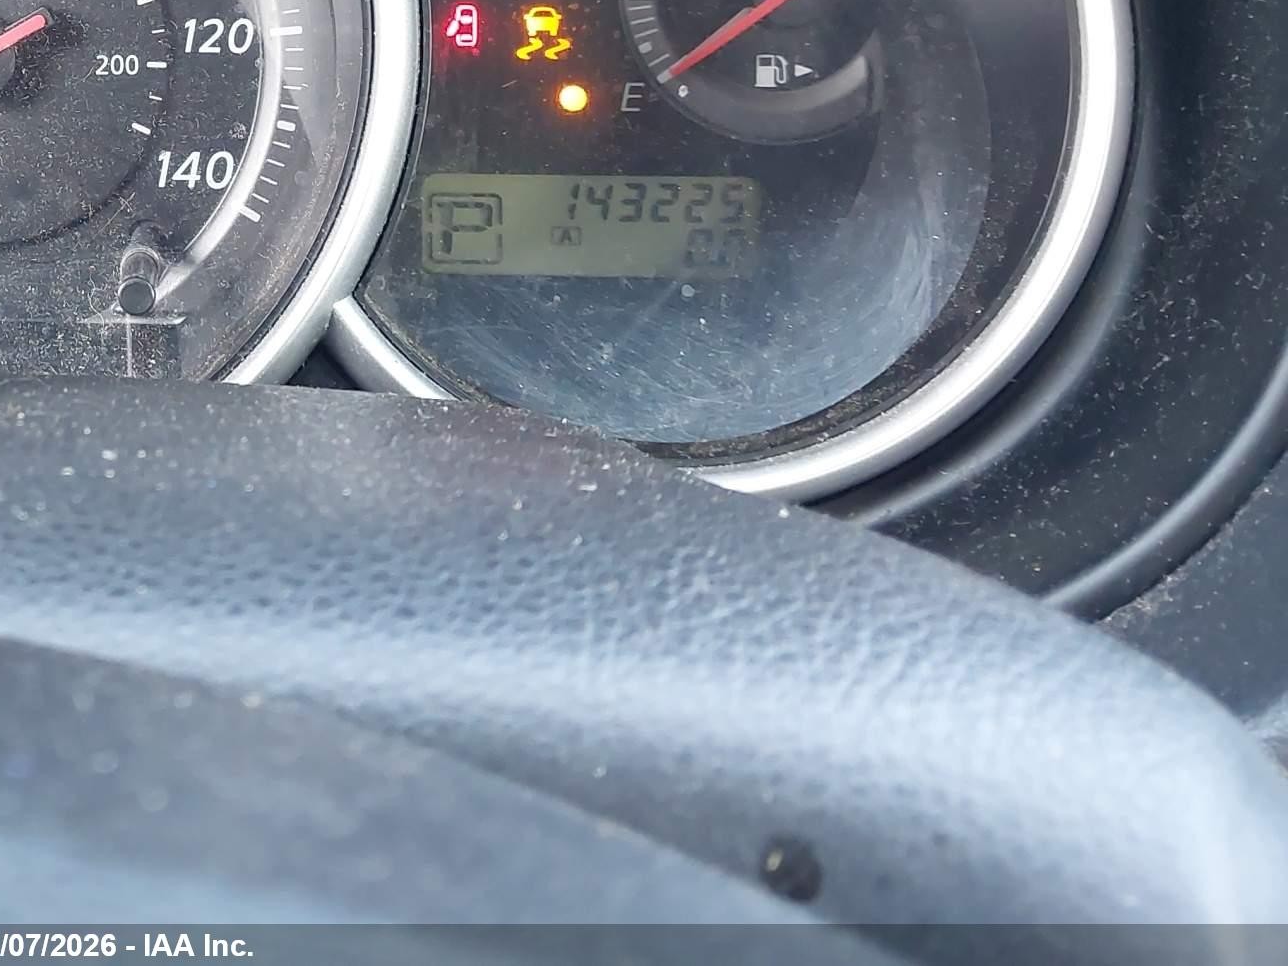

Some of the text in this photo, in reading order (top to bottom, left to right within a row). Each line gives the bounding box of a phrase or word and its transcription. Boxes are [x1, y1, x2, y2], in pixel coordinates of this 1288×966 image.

[184, 18, 254, 54] 120
[95, 55, 139, 75] 200
[620, 82, 645, 112] E
[157, 151, 234, 190] 140
[567, 183, 745, 223] 143225
